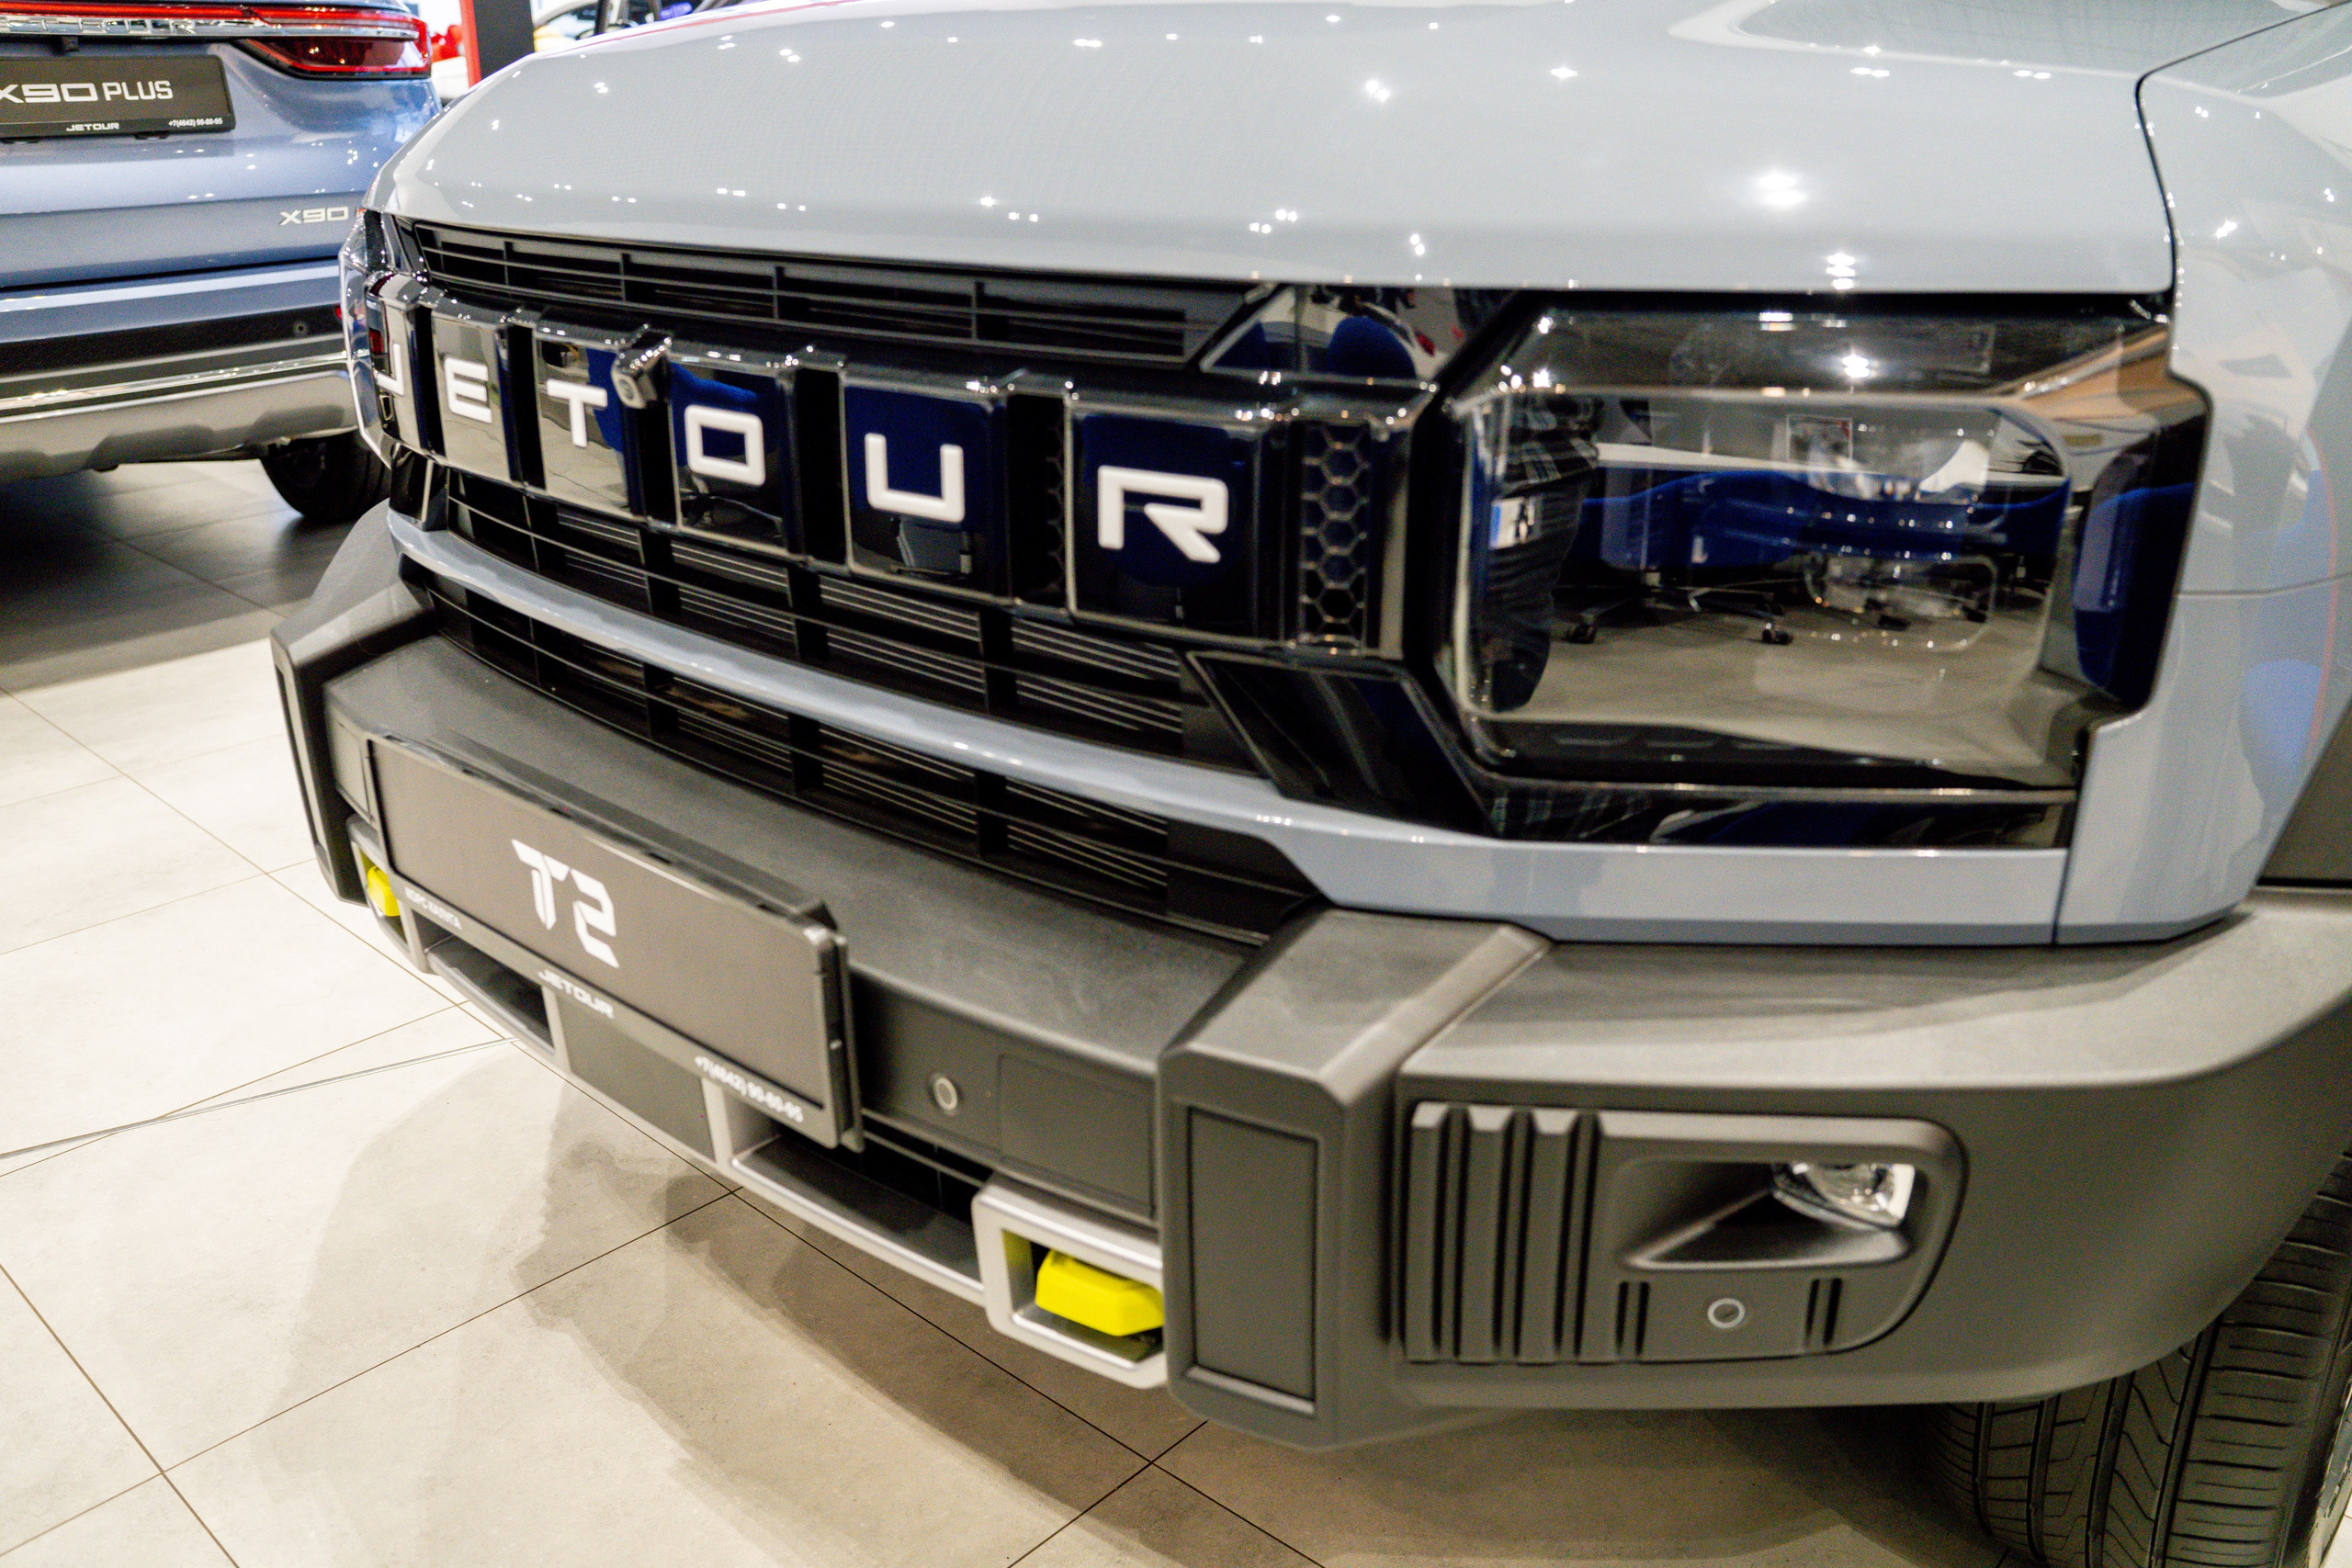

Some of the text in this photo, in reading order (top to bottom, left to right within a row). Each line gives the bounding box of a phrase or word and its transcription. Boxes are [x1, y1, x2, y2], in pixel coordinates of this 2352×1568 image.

[102, 80, 173, 101] PLUS
[66, 122, 119, 131] JETOUR
[279, 207, 349, 225] X90
[374, 343, 1229, 564] JETOUR
[511, 838, 620, 969] T2
[537, 969, 615, 1020] JETOUR
